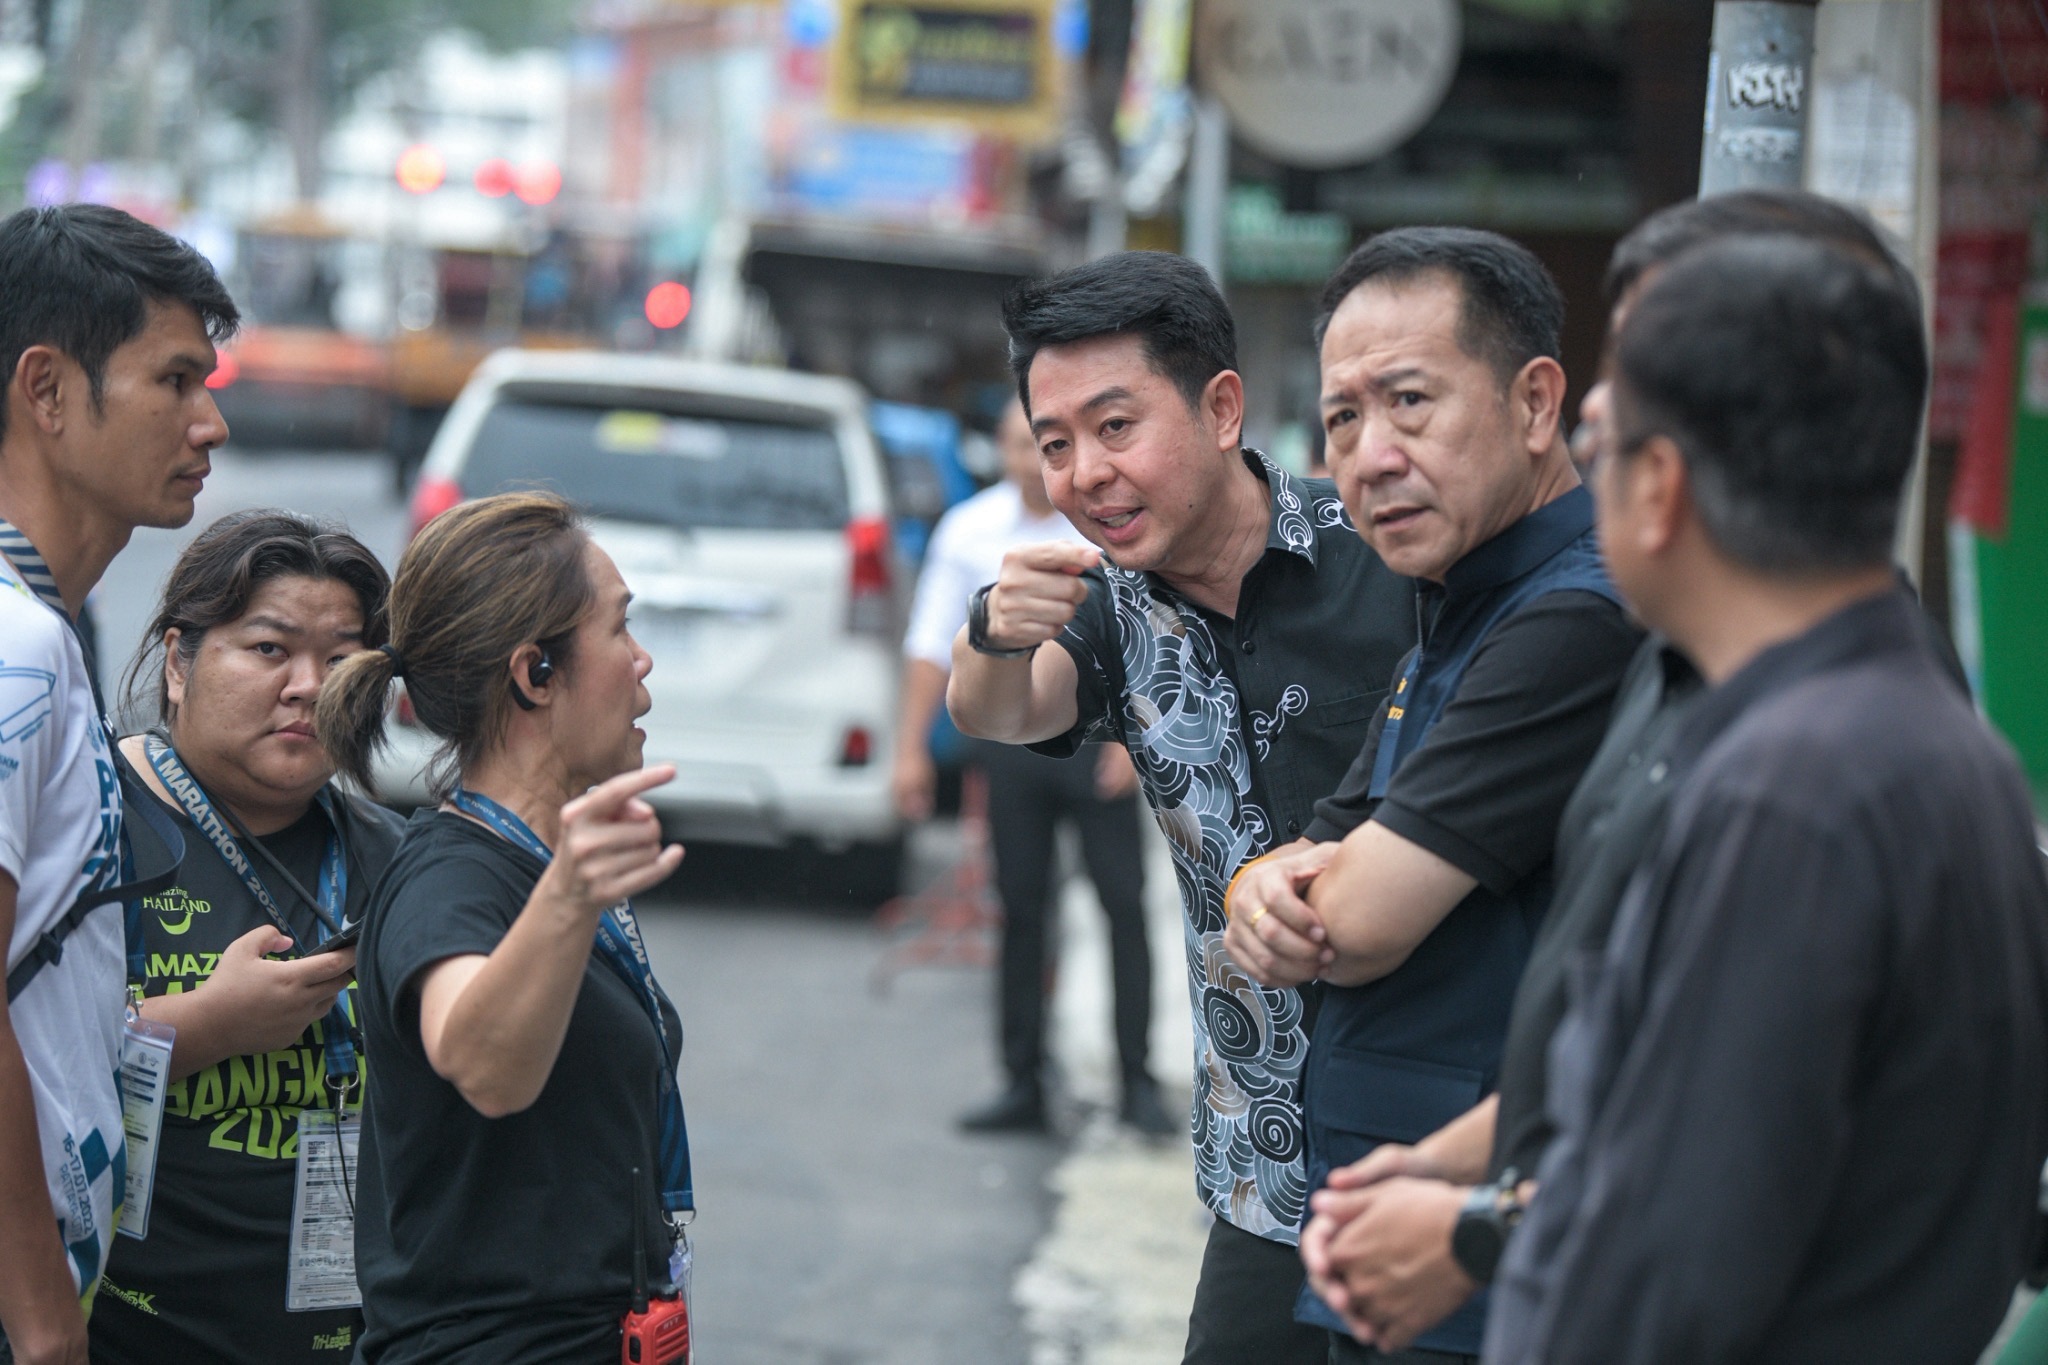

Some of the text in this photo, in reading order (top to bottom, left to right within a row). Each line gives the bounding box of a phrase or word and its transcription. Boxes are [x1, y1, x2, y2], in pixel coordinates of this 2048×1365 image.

[158, 757, 248, 876] MARATHON
[143, 896, 211, 913] HAILAND
[160, 886, 189, 899] azing
[614, 897, 648, 964] MAR
[145, 953, 224, 978] MAZ
[208, 1105, 299, 1160] 202
[60, 1163, 79, 1215] PATTAYA
[101, 1280, 138, 1307] OVEMBER
